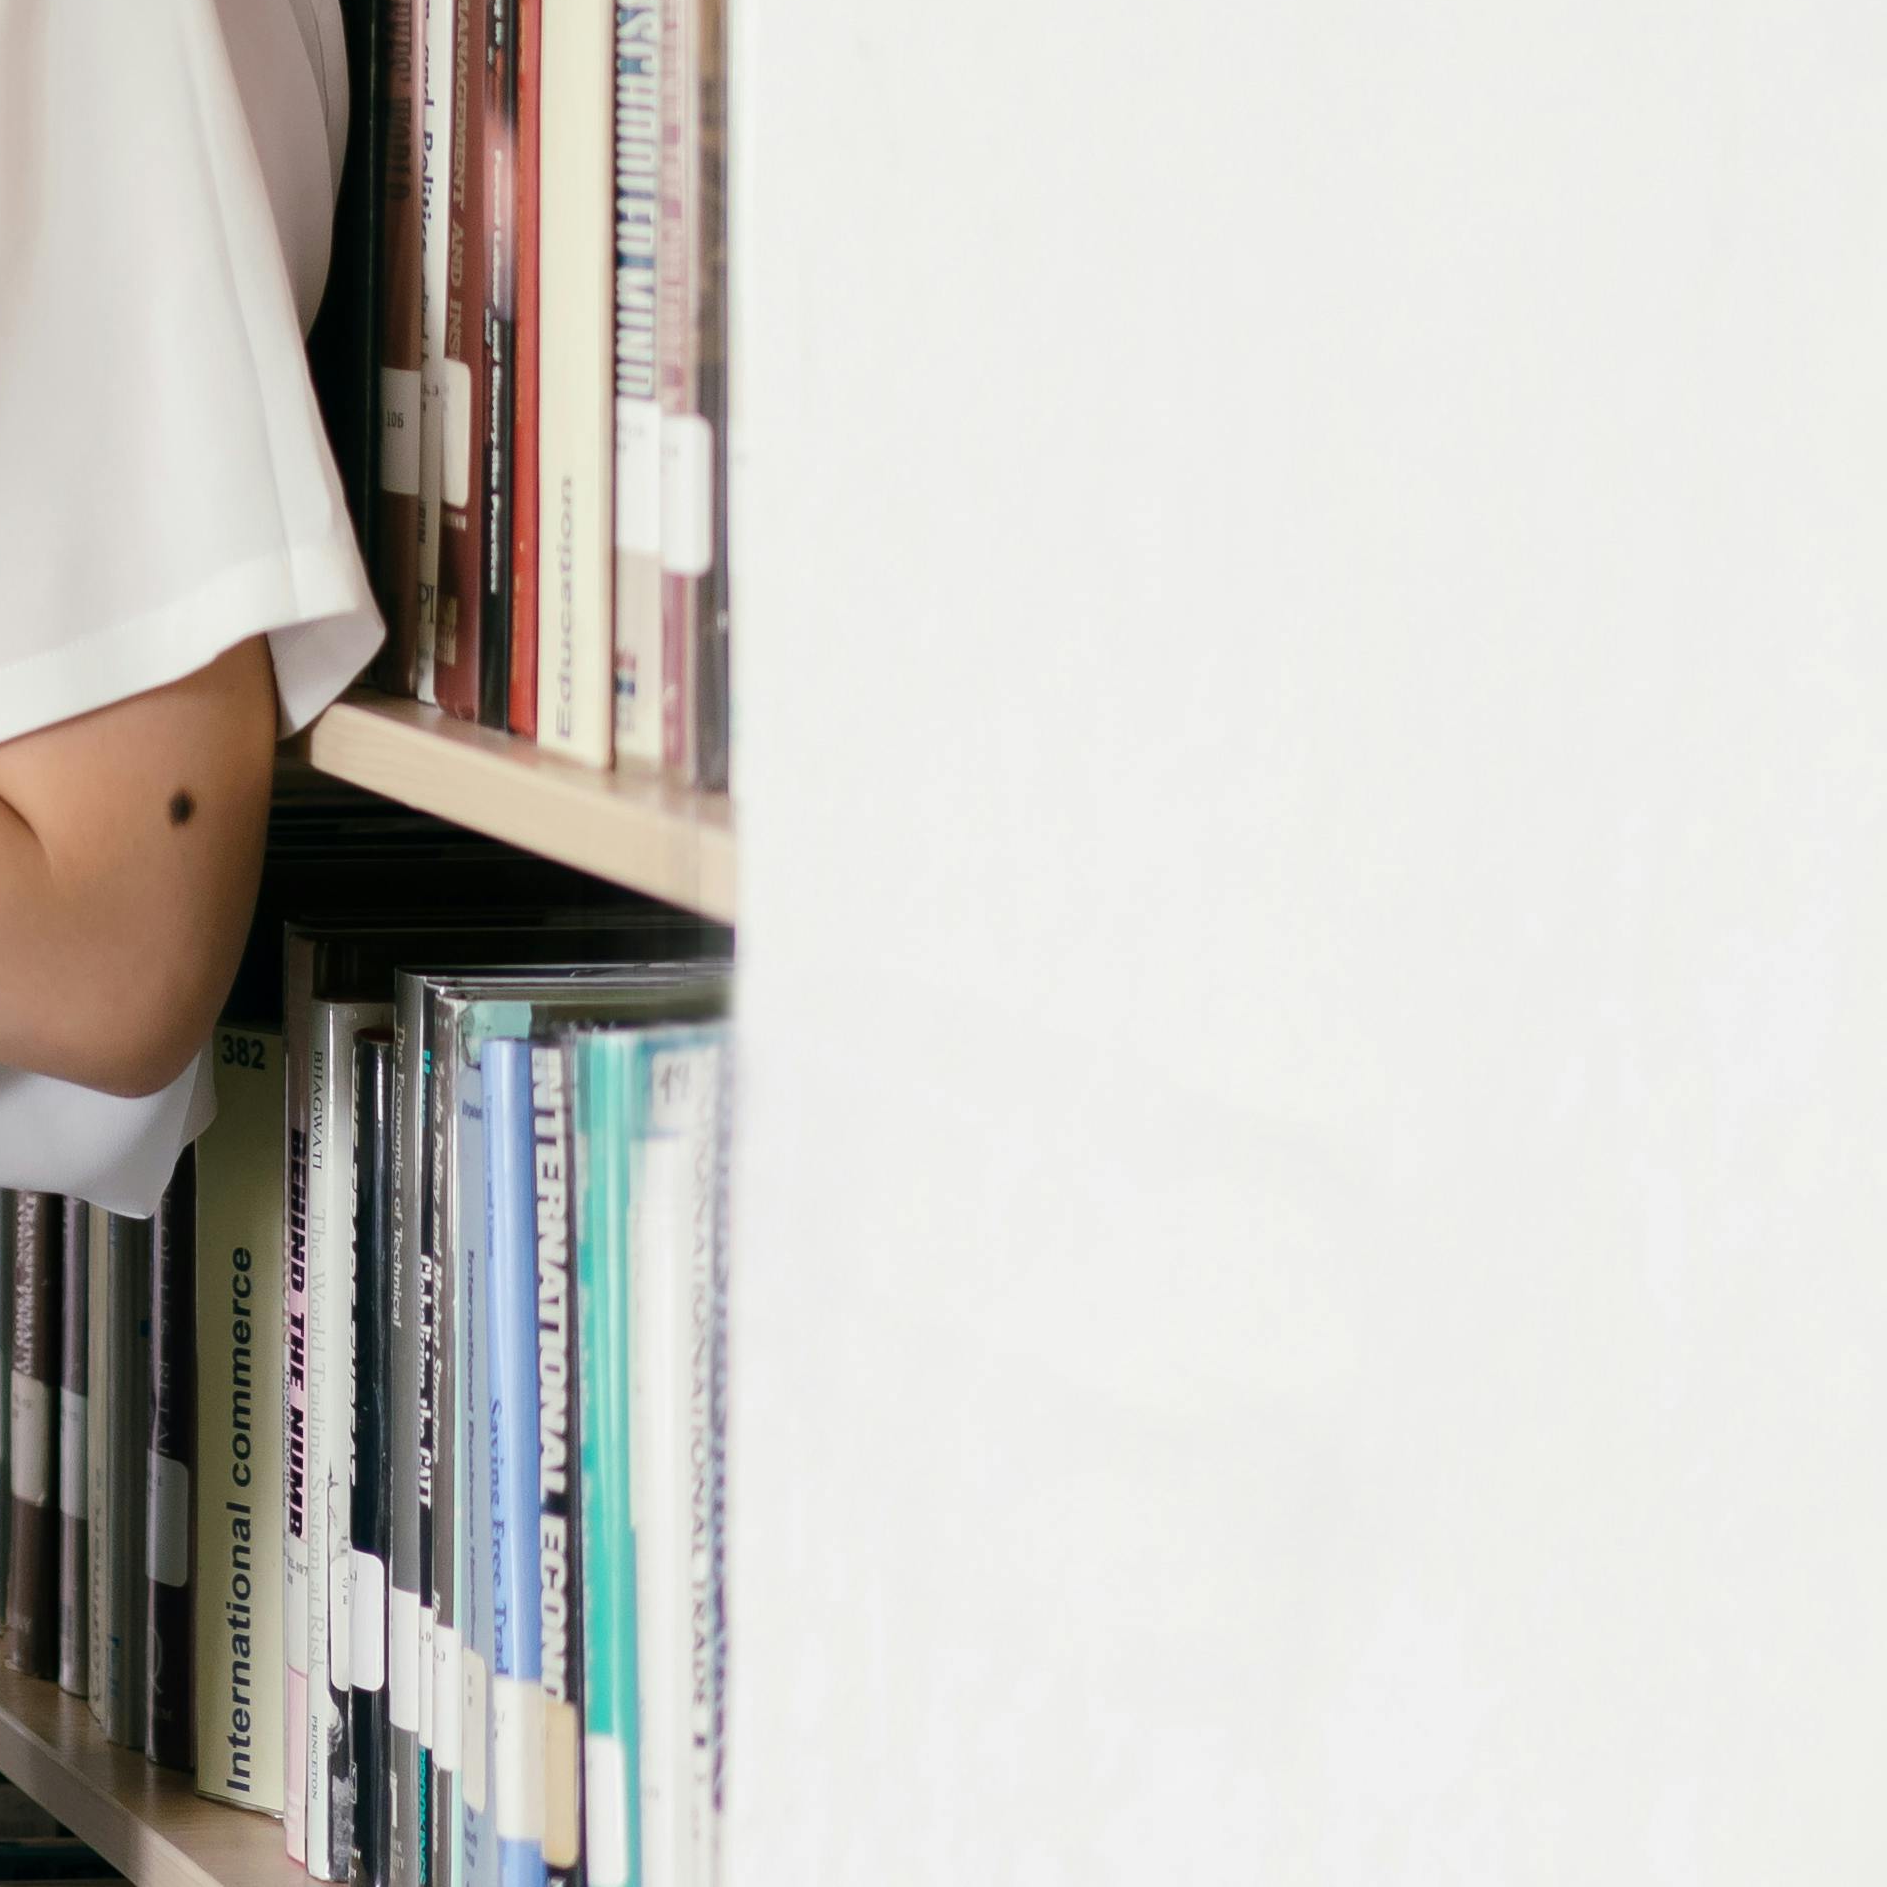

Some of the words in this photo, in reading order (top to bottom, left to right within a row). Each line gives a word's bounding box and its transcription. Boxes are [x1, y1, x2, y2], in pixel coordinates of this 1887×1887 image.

[423, 45, 436, 108] and
[422, 130, 436, 256] Politics
[451, 218, 464, 287] AND
[616, 266, 659, 401] MIND
[386, 411, 404, 428] 106
[556, 474, 573, 740] Education
[221, 1033, 266, 1070] 382
[394, 1023, 406, 1065] The
[311, 1049, 324, 1171] BHAGWATI
[394, 1072, 406, 1190] Economics
[433, 1060, 445, 1124] Trade
[392, 1196, 403, 1222] of
[433, 1131, 444, 1205] Policy
[290, 1127, 307, 1294] BEHIND
[311, 1208, 326, 1259] The
[433, 1211, 443, 1259] and
[311, 1270, 326, 1352] World
[392, 1227, 403, 1329] Technical
[432, 1262, 442, 1349] Market
[532, 1047, 568, 1504] INTERNATIONAL
[289, 1312, 305, 1392] THE
[418, 1253, 433, 1390] Globalizing
[467, 1249, 475, 1415] International
[231, 1244, 253, 1490] commerce
[432, 1355, 442, 1463] Structure
[309, 1363, 325, 1465] Trading
[418, 1397, 432, 1439] the
[489, 1397, 505, 1507] Saving
[418, 1446, 433, 1511] GATT
[309, 1474, 325, 1572] System
[491, 1519, 506, 1588] Free
[310, 1581, 324, 1601] at
[225, 1499, 251, 1794] International
[310, 1614, 325, 1675] Risk
[493, 1600, 510, 1676] Trad
[311, 1714, 319, 1801] PRINCETON
